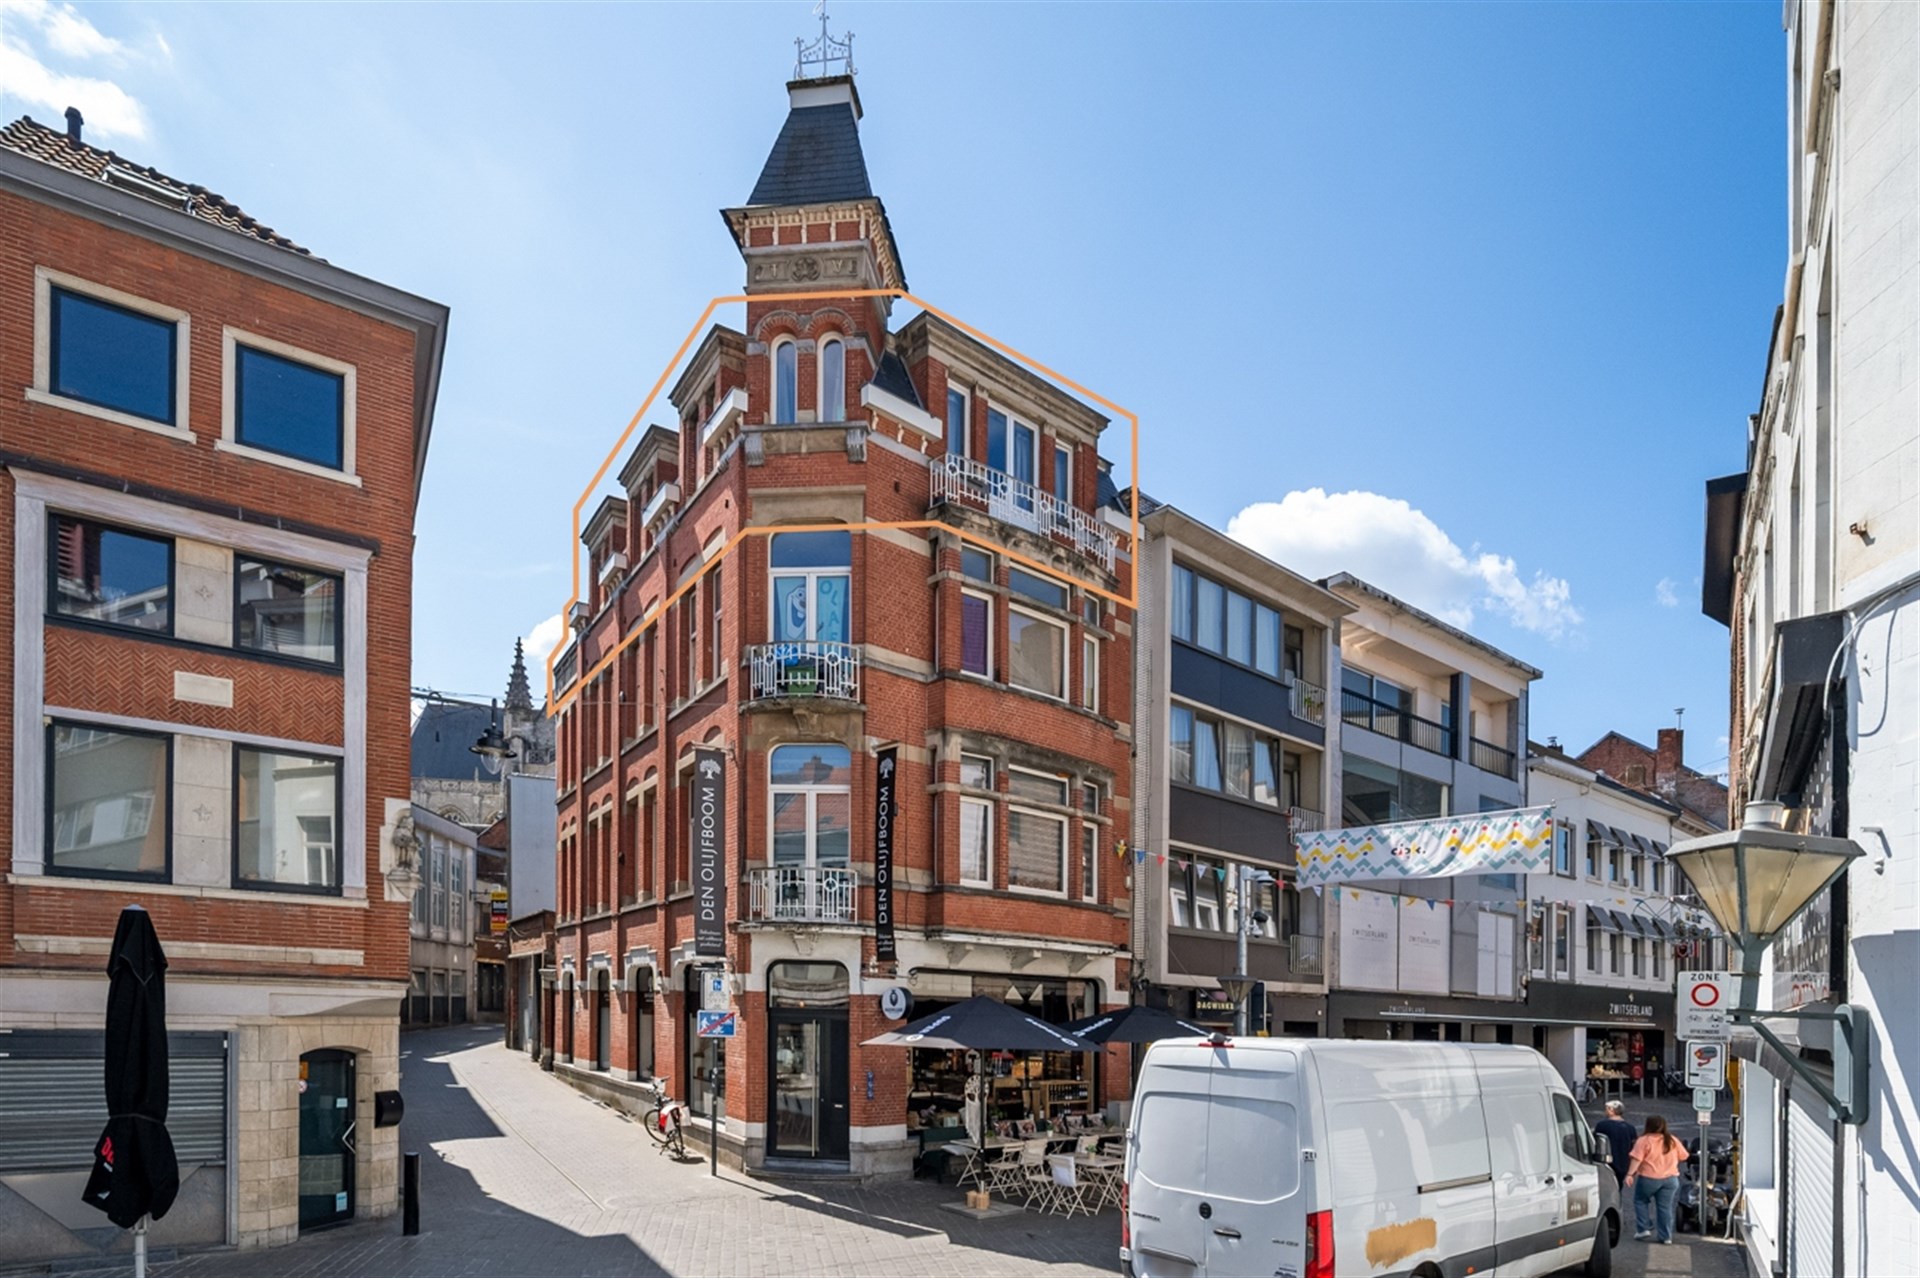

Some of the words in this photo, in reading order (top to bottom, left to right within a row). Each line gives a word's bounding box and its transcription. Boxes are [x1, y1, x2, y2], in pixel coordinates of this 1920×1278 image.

[701, 786, 718, 882] OLIJFBOOM
[877, 787, 890, 884] OLIJFBOOM
[701, 887, 715, 921] DEN
[878, 889, 888, 925] DEN
[1690, 972, 1721, 982] ZONE
[1608, 1003, 1653, 1016] ZWITSERLAND
